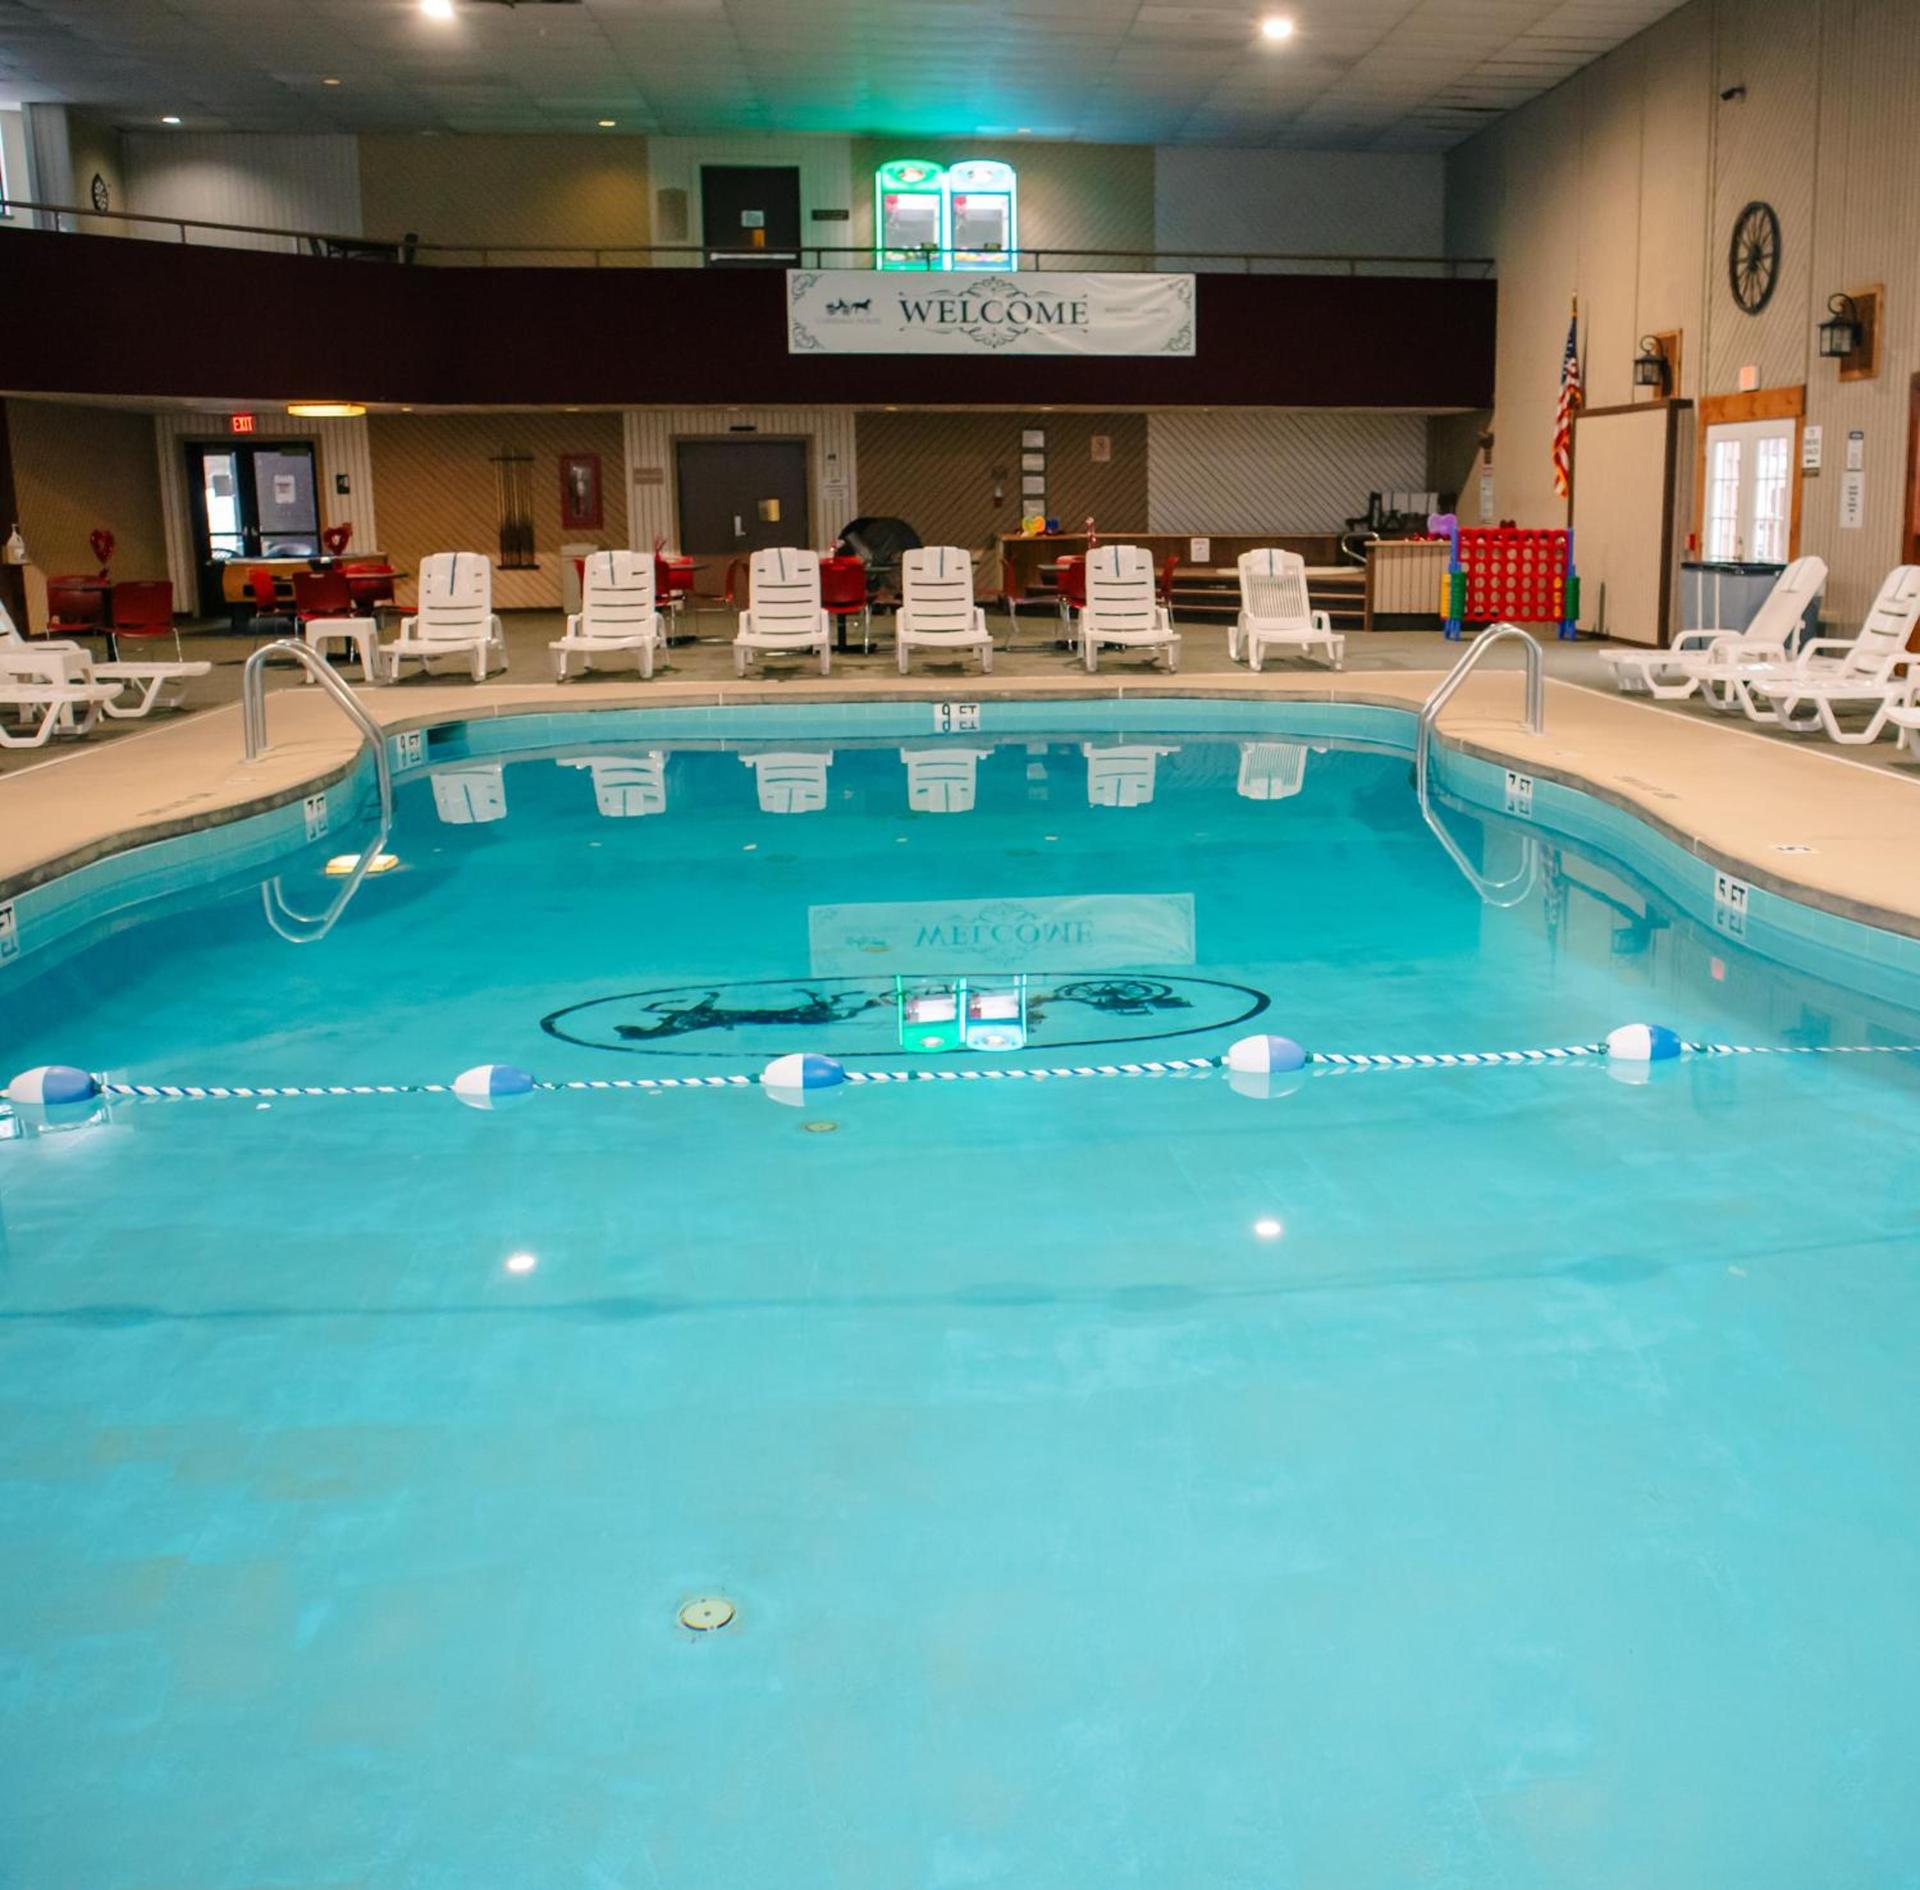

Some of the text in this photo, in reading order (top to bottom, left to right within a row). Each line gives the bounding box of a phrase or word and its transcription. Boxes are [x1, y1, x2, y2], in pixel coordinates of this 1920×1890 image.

[899, 299, 1089, 325] WELCOME
[232, 416, 253, 432] EXIT
[959, 704, 977, 716] FT
[1508, 773, 1532, 795] 7 FT
[1731, 884, 1746, 907] FT
